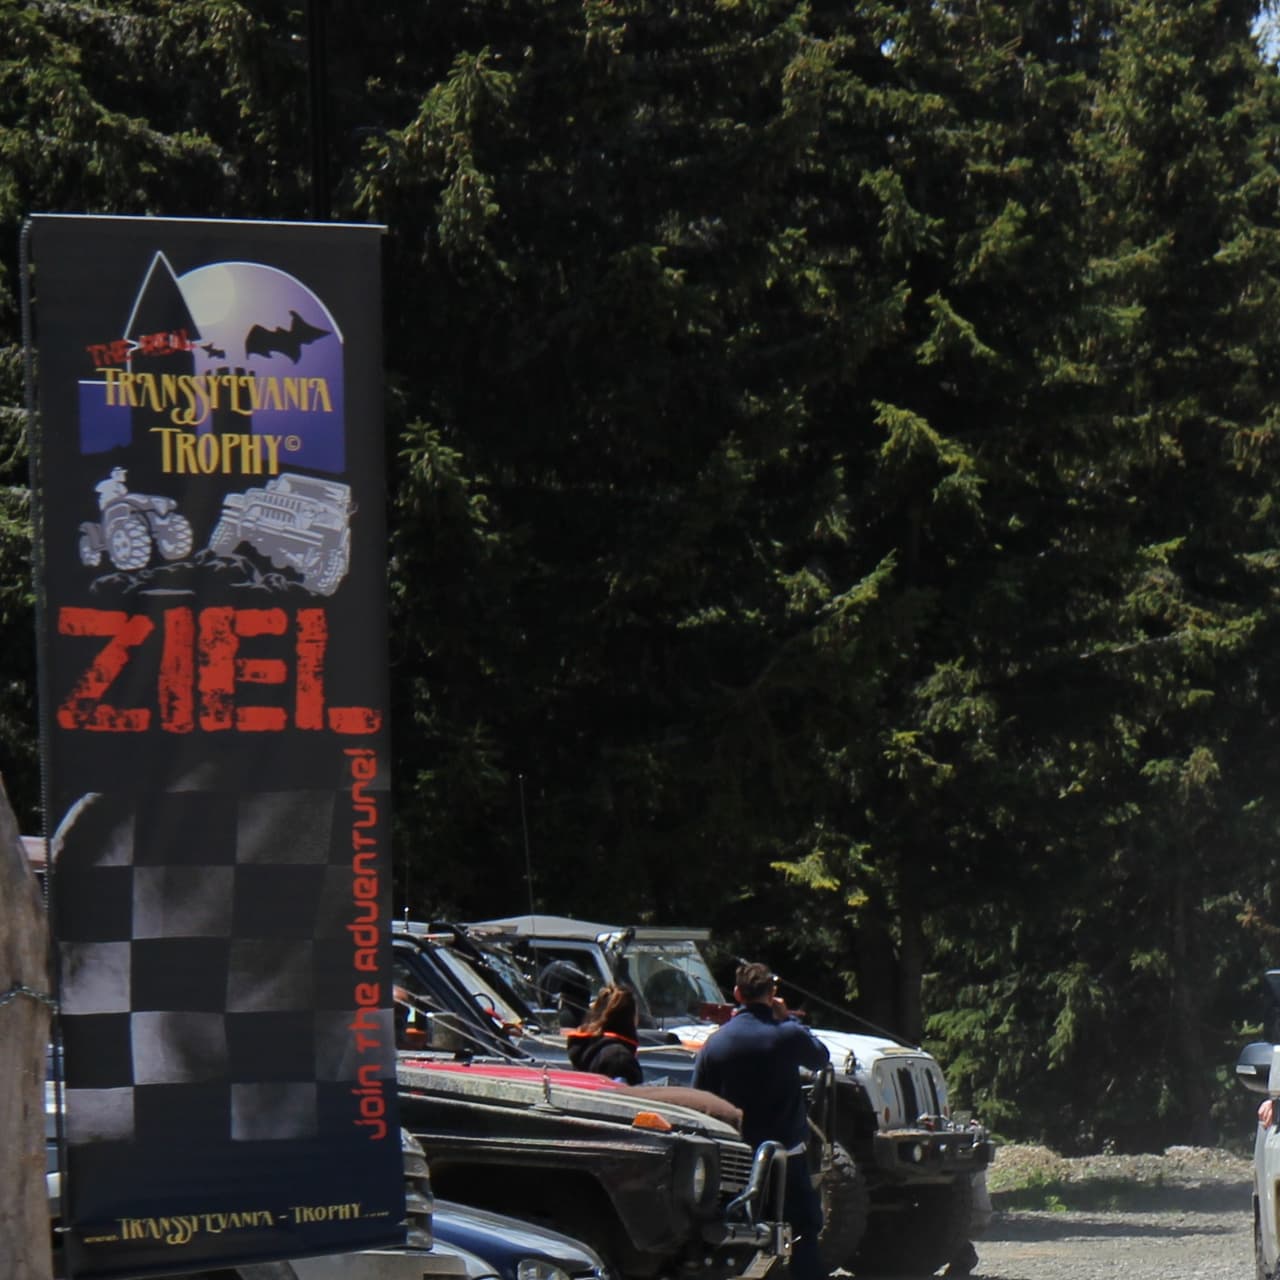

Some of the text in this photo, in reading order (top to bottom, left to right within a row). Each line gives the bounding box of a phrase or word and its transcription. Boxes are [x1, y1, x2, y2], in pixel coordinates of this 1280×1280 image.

[86, 337, 132, 366] THE
[57, 606, 383, 734] ZIEL
[290, 1202, 362, 1224] TROPHY
